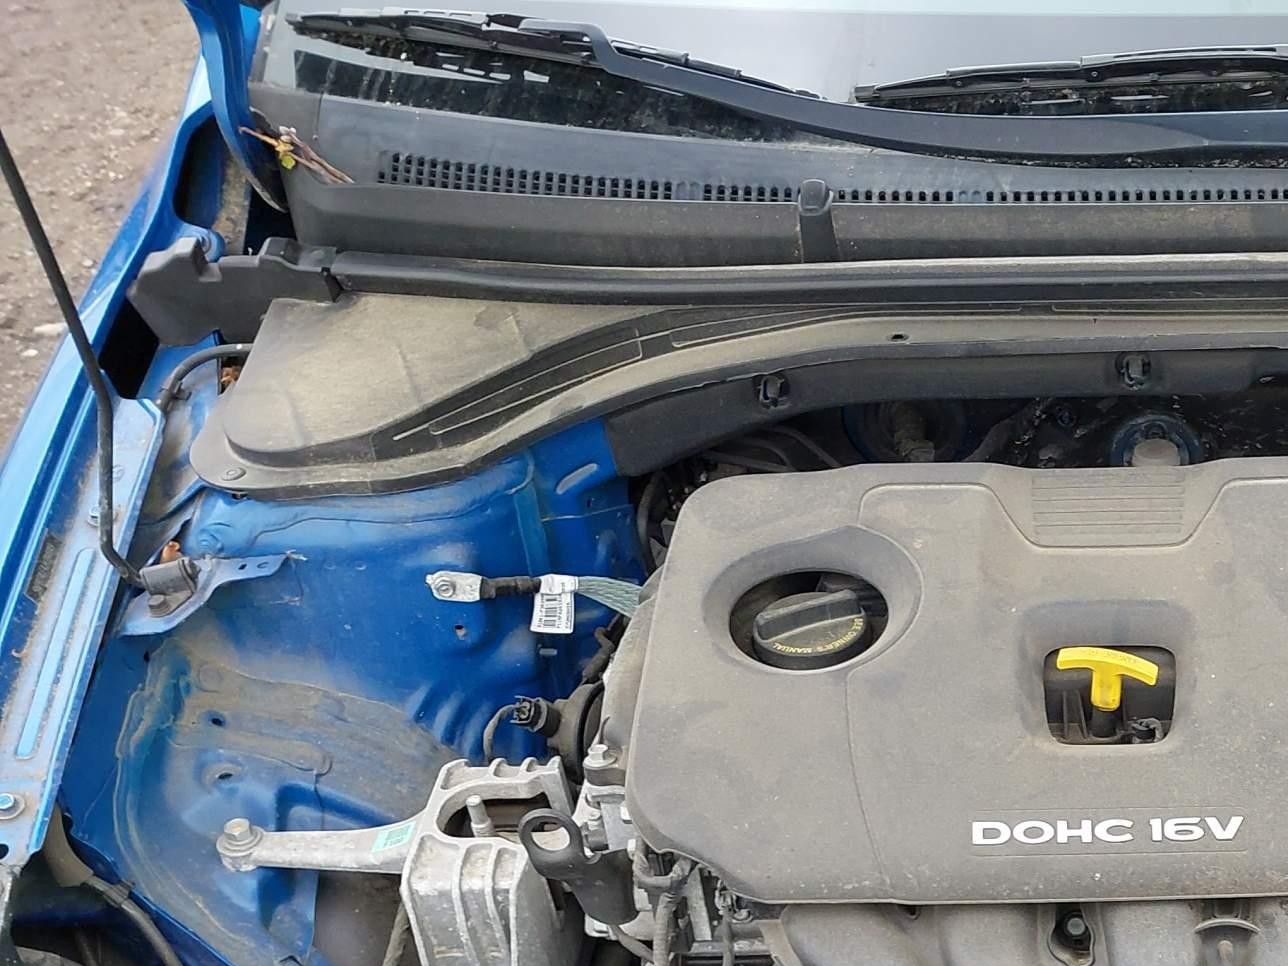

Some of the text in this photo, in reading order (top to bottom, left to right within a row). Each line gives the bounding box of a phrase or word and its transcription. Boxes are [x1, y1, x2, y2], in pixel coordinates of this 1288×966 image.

[772, 641, 813, 655] MANUAL
[972, 815, 1244, 846] DOHC 16V
